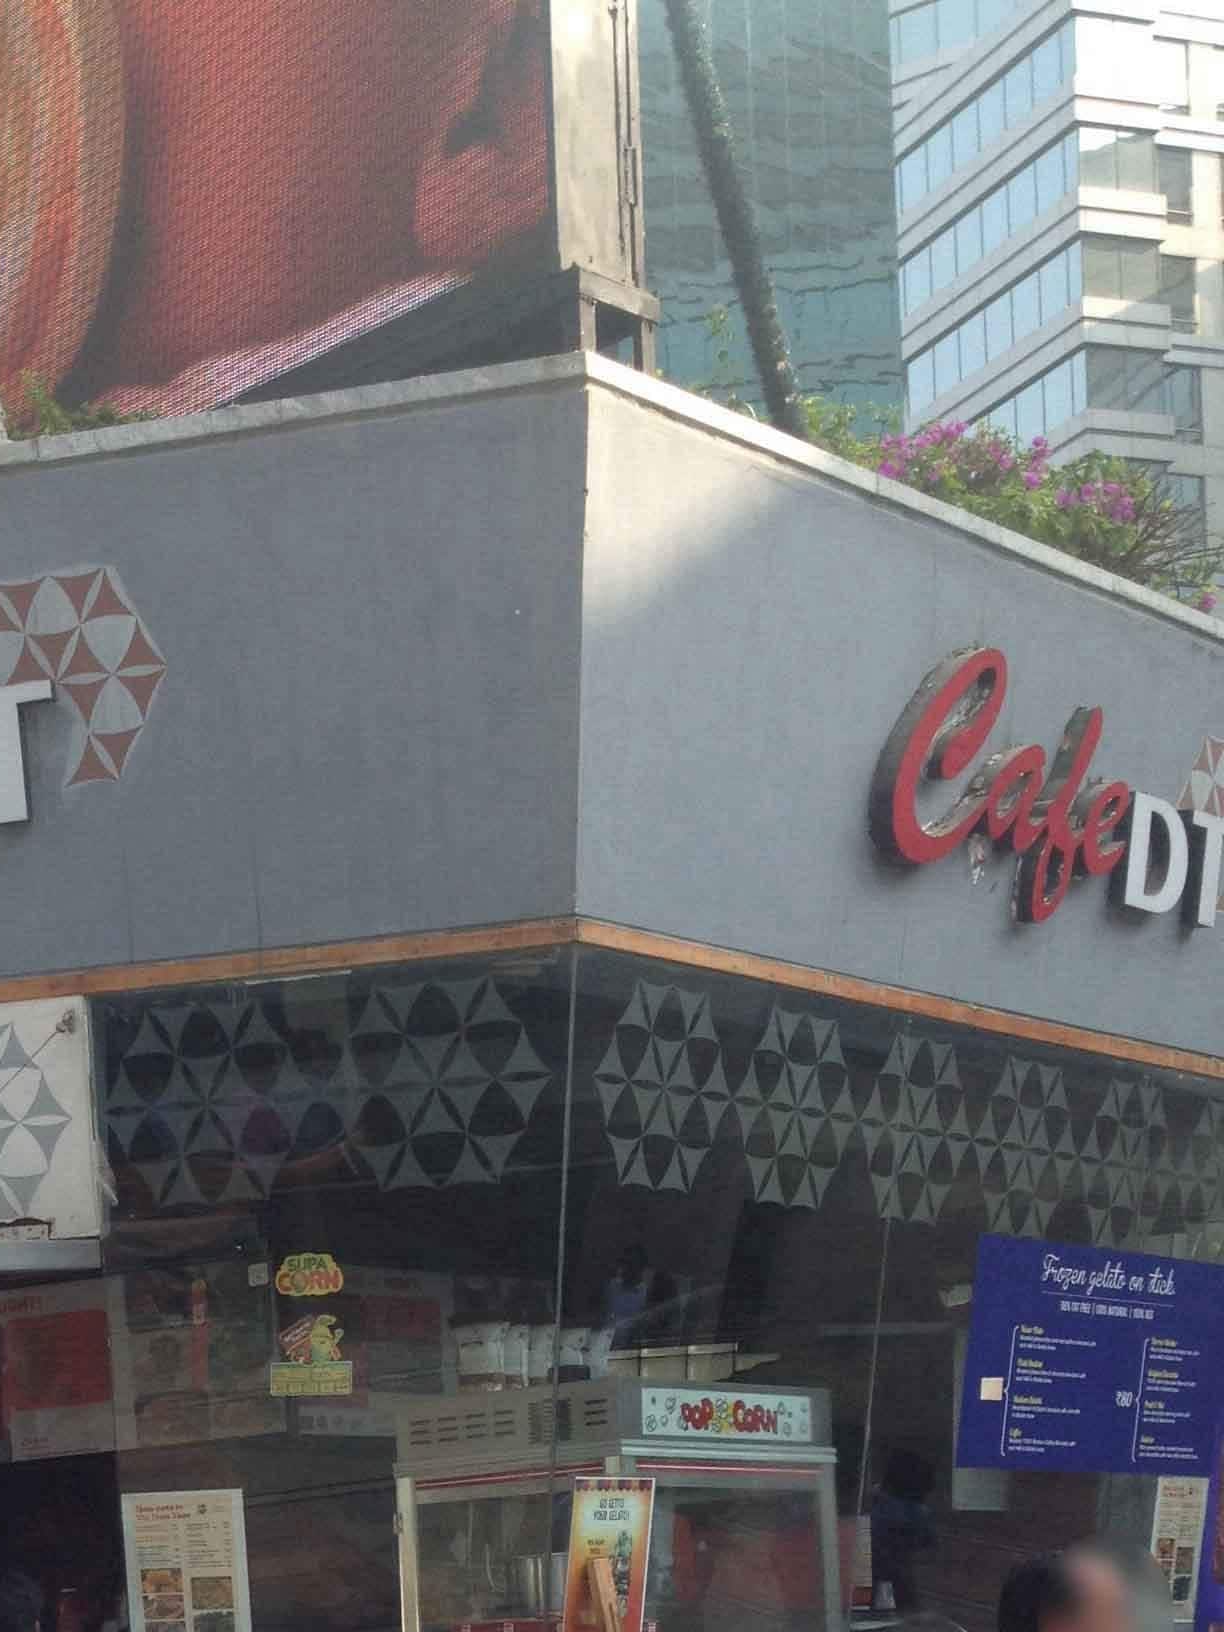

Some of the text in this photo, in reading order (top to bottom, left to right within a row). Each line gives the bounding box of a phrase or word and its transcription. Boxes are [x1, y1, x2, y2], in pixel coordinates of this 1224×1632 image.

[287, 1256, 326, 1271] SUPA
[1041, 1253, 1086, 1290] Frozen
[1087, 1260, 1126, 1295] gelato
[1129, 1275, 1144, 1292] on
[278, 1271, 341, 1292] CORN
